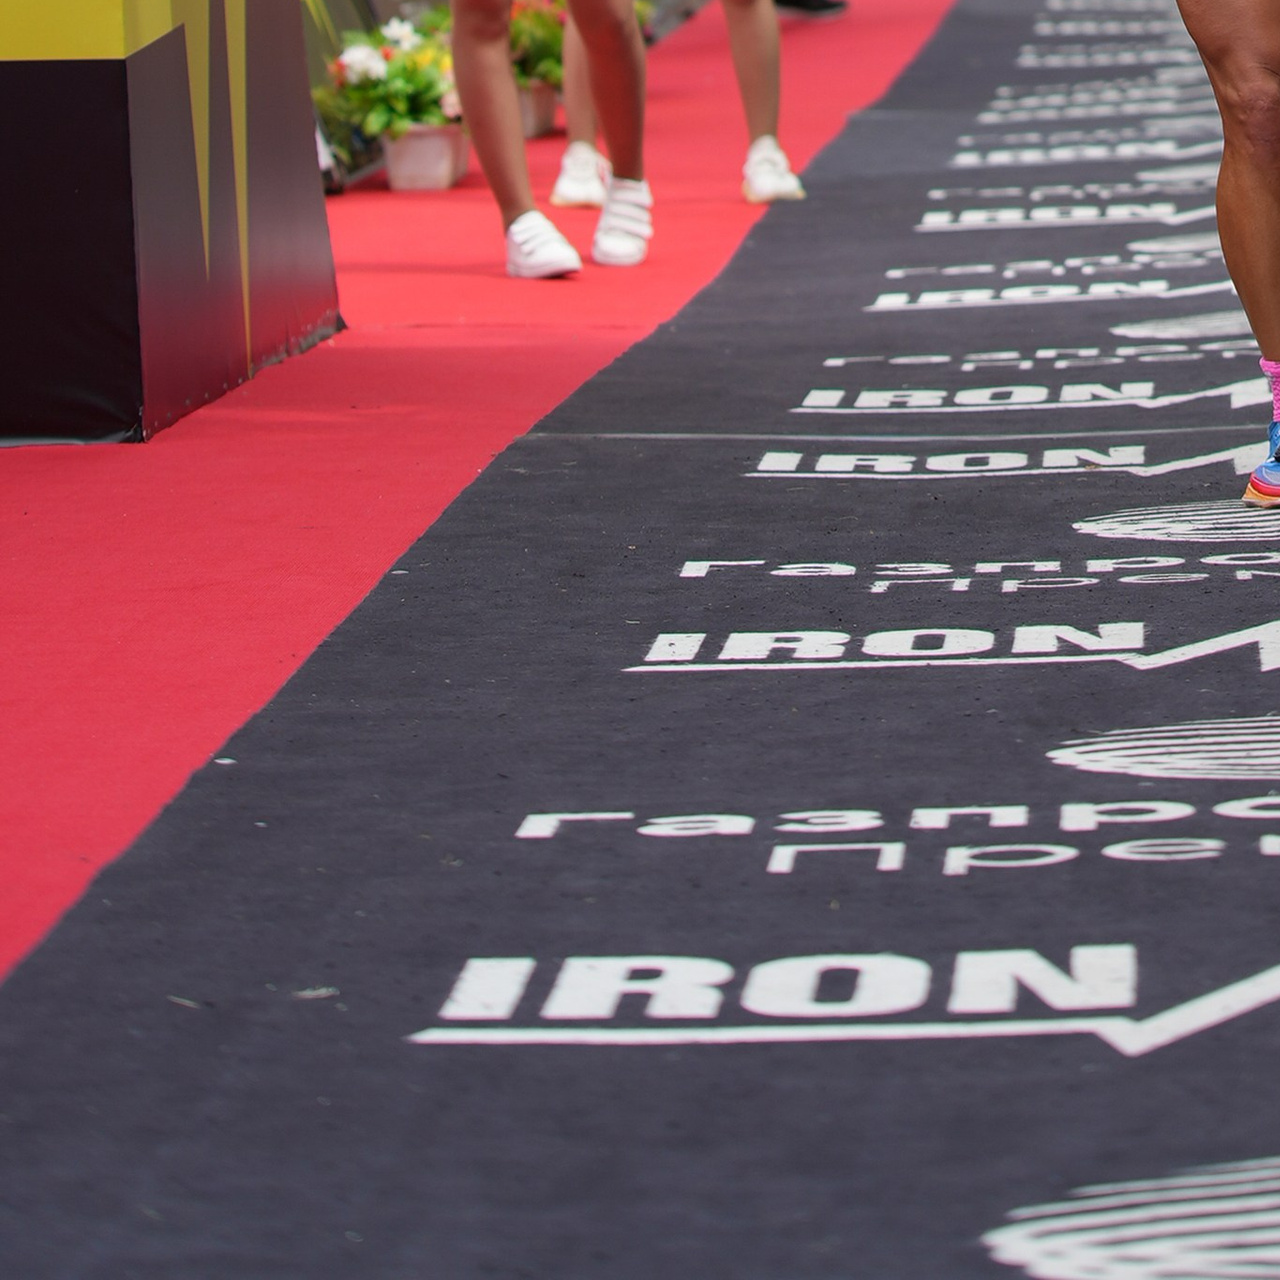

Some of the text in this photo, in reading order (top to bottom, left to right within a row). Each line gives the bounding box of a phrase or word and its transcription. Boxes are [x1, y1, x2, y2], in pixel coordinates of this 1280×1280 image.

[873, 279, 1169, 307] IRON
[800, 381, 1154, 408] IRON
[756, 445, 1146, 472] IRON
[644, 621, 1145, 662] IRON
[440, 944, 1138, 1020] IRON
